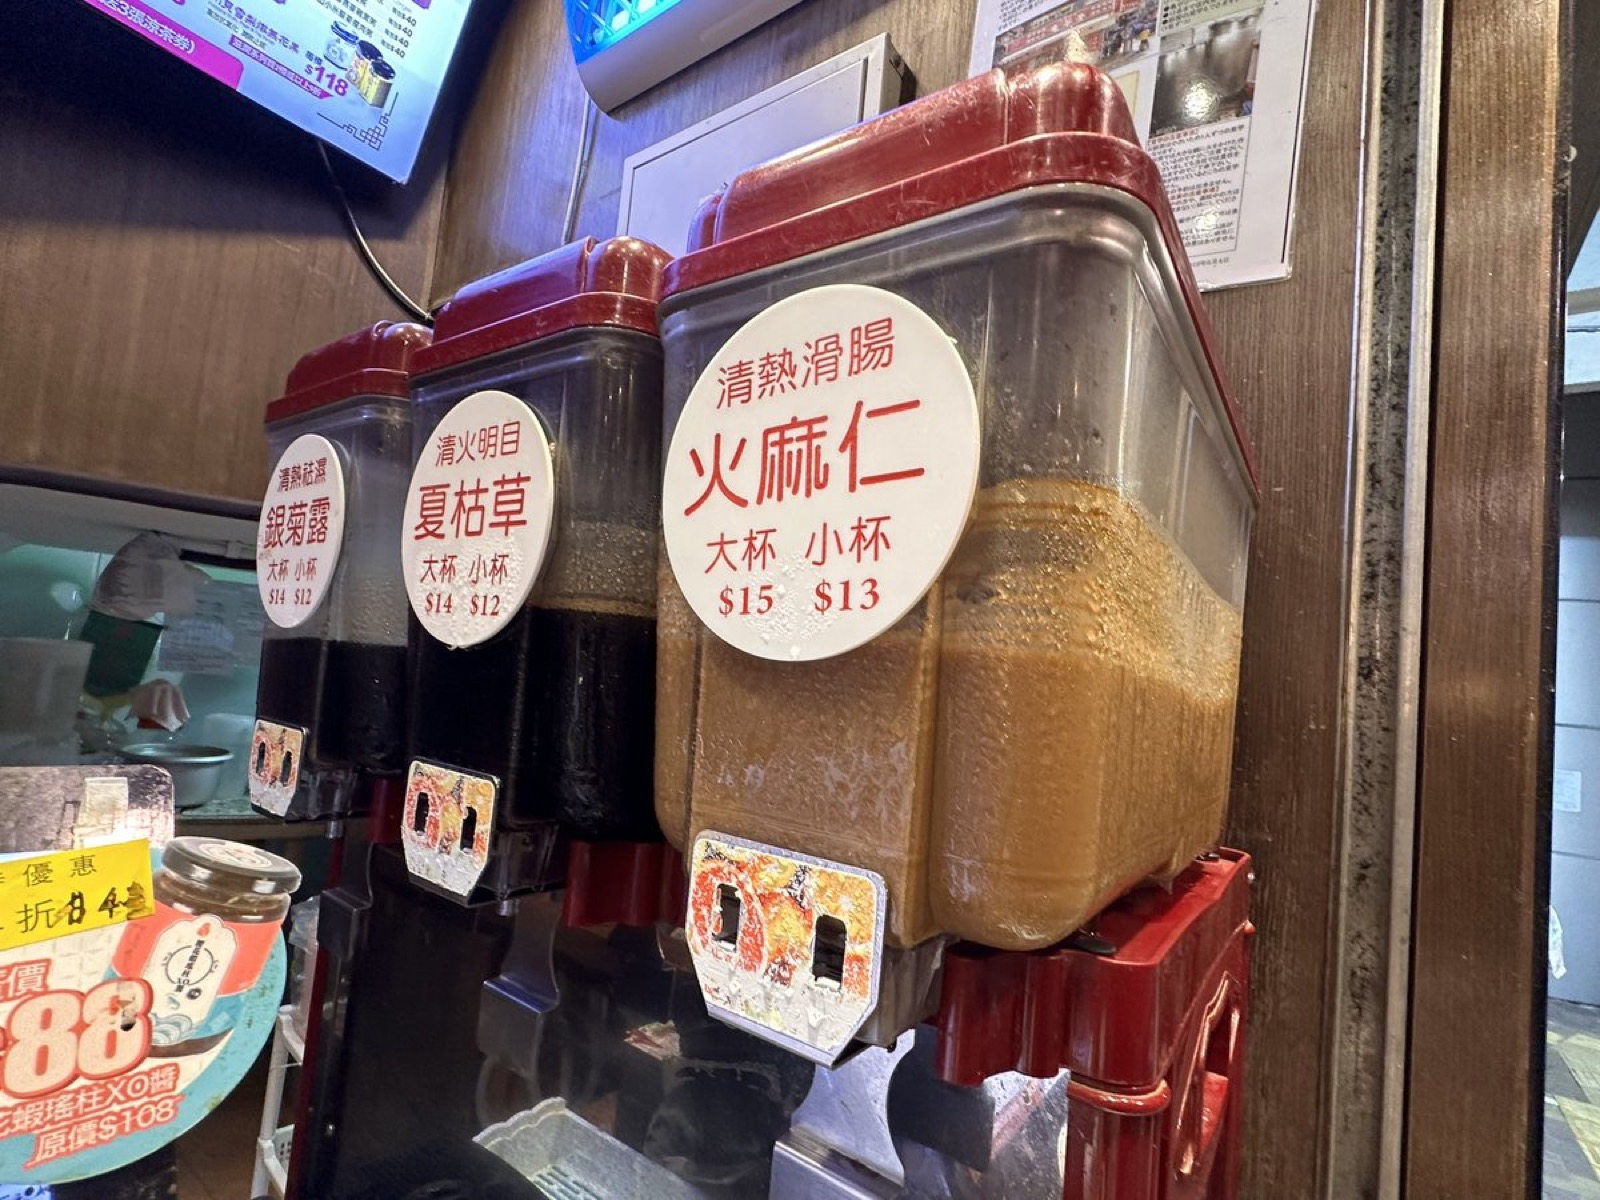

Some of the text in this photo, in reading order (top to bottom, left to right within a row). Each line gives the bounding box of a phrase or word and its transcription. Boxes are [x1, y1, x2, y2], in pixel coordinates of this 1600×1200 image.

[304, 63, 349, 97] $118
[716, 317, 896, 410] 清熱滑腸
[435, 420, 521, 467] 清火明目
[684, 399, 925, 517] 火麻仁
[264, 496, 331, 549] 銀菊露
[413, 471, 531, 541] 夏枯草
[704, 515, 892, 574] 大杯 小杯
[267, 557, 318, 582] 大杯 小杯
[420, 552, 510, 587] 大杯 小杯
[268, 588, 312, 605] $14 $12
[425, 592, 500, 617] $14 $12
[718, 577, 880, 618] $15 $13
[0, 854, 97, 888] 優惠
[0, 898, 55, 934] 折
[0, 977, 152, 1097] 88
[36, 1099, 175, 1161] 原價$108
